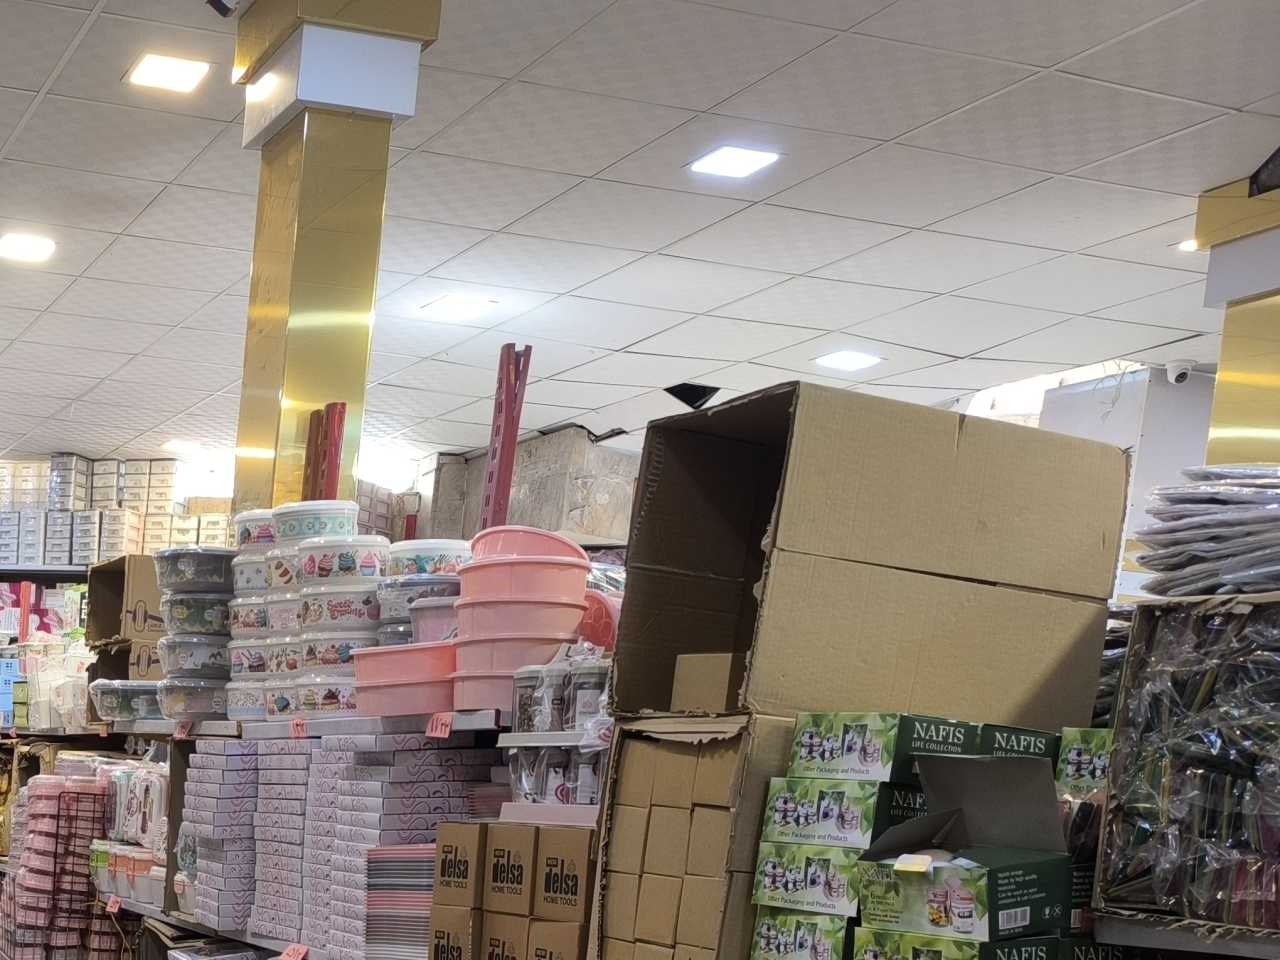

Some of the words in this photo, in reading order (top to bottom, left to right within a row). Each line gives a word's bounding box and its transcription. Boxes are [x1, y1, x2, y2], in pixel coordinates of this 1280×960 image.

[327, 598, 354, 612] Sweet
[913, 721, 964, 744] NAFIS
[911, 740, 924, 749] LIFE
[925, 742, 962, 753] COLLECTION
[994, 732, 1046, 754] NAFIS
[816, 767, 840, 775] Packaging
[891, 808, 902, 816] LIFE
[791, 831, 817, 840] Packaging
[827, 834, 848, 842] Products
[440, 846, 469, 879] delsa
[492, 850, 523, 885] delsa
[544, 859, 578, 896] delsa
[439, 880, 453, 888] HOME
[453, 880, 468, 889] TOOLS
[491, 886, 506, 894] HOME
[506, 887, 522, 895] TOOLS
[543, 896, 559, 905] HOME
[559, 897, 577, 906] TOOLS
[870, 890, 876, 899] 6
[781, 897, 805, 907] Packaging
[815, 901, 836, 910] Products
